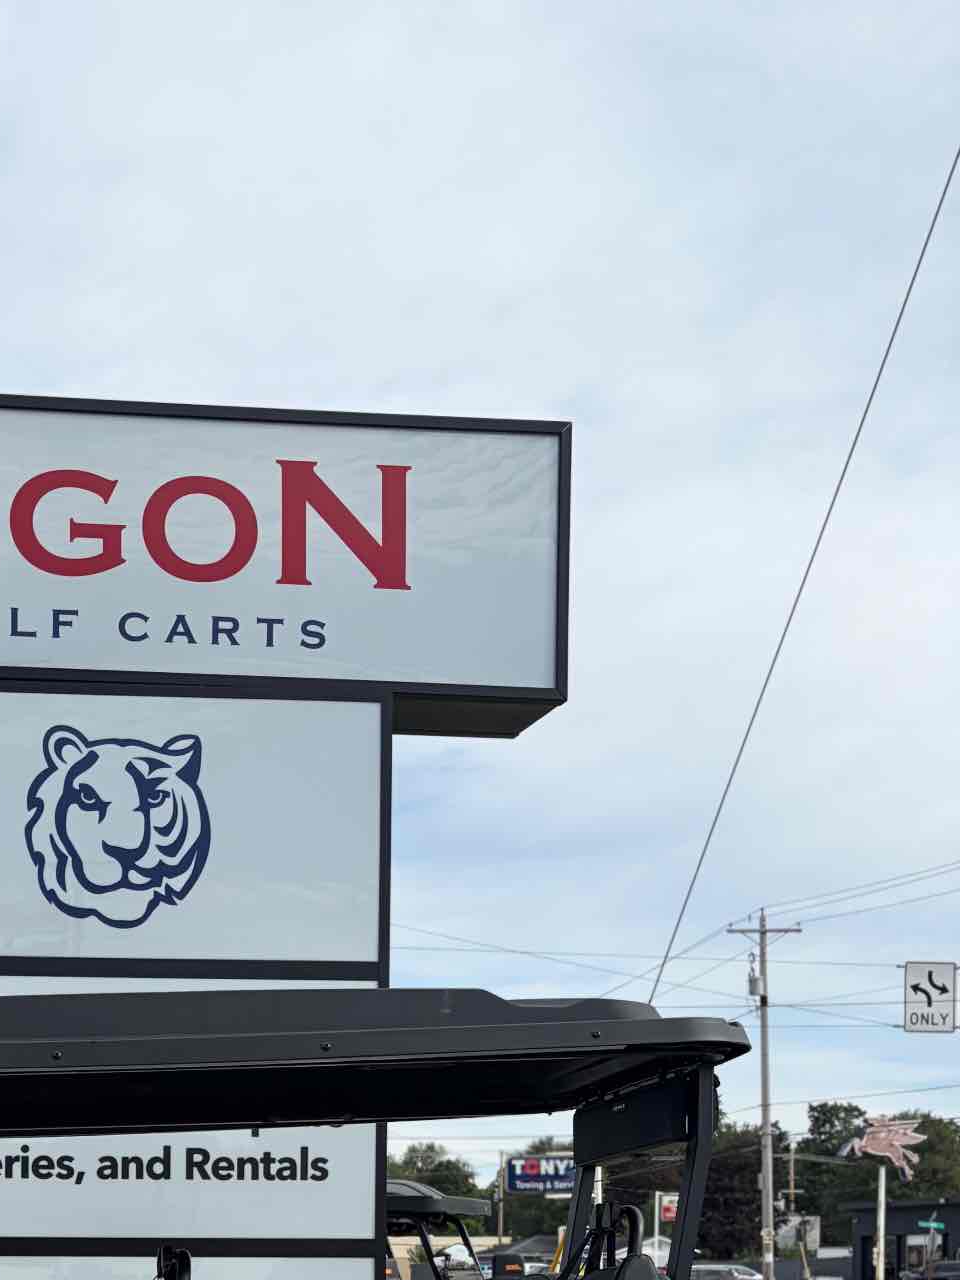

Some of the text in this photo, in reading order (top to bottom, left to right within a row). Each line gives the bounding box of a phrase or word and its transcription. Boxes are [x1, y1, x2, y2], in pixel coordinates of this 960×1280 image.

[118, 611, 328, 650] CARTS
[910, 1011, 949, 1026] ONLY
[96, 1145, 172, 1181] and
[184, 1146, 330, 1182] Rentals
